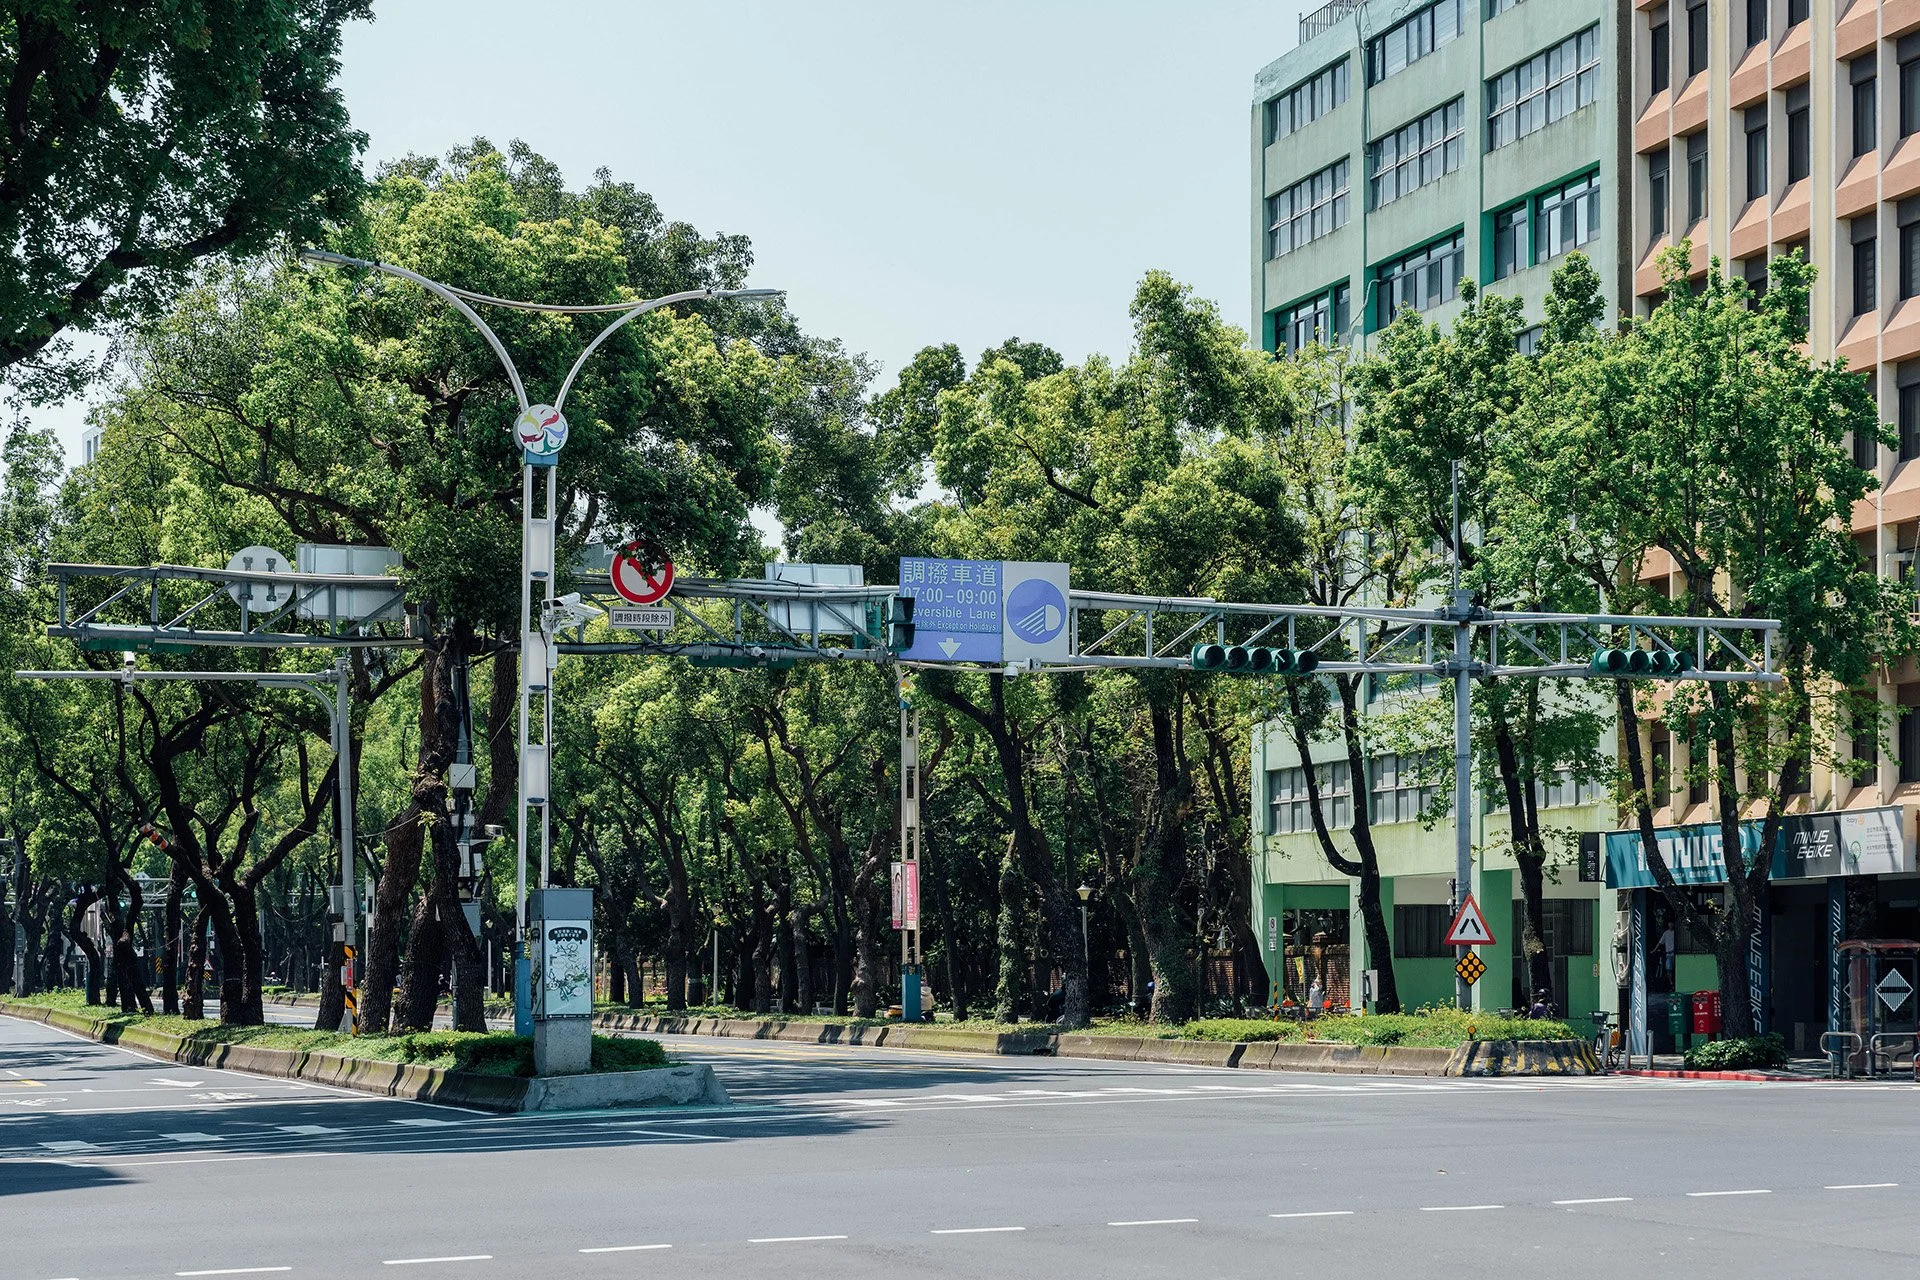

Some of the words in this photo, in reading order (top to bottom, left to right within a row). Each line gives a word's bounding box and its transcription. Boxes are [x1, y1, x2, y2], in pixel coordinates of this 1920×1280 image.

[903, 561, 997, 587] 調撥車道
[912, 606, 962, 619] eversible
[969, 608, 997, 619] Lane
[937, 620, 959, 631] Except
[969, 622, 997, 632] Holidays
[1793, 830, 1830, 844] MINUS
[1797, 844, 1833, 859] E-BIKE
